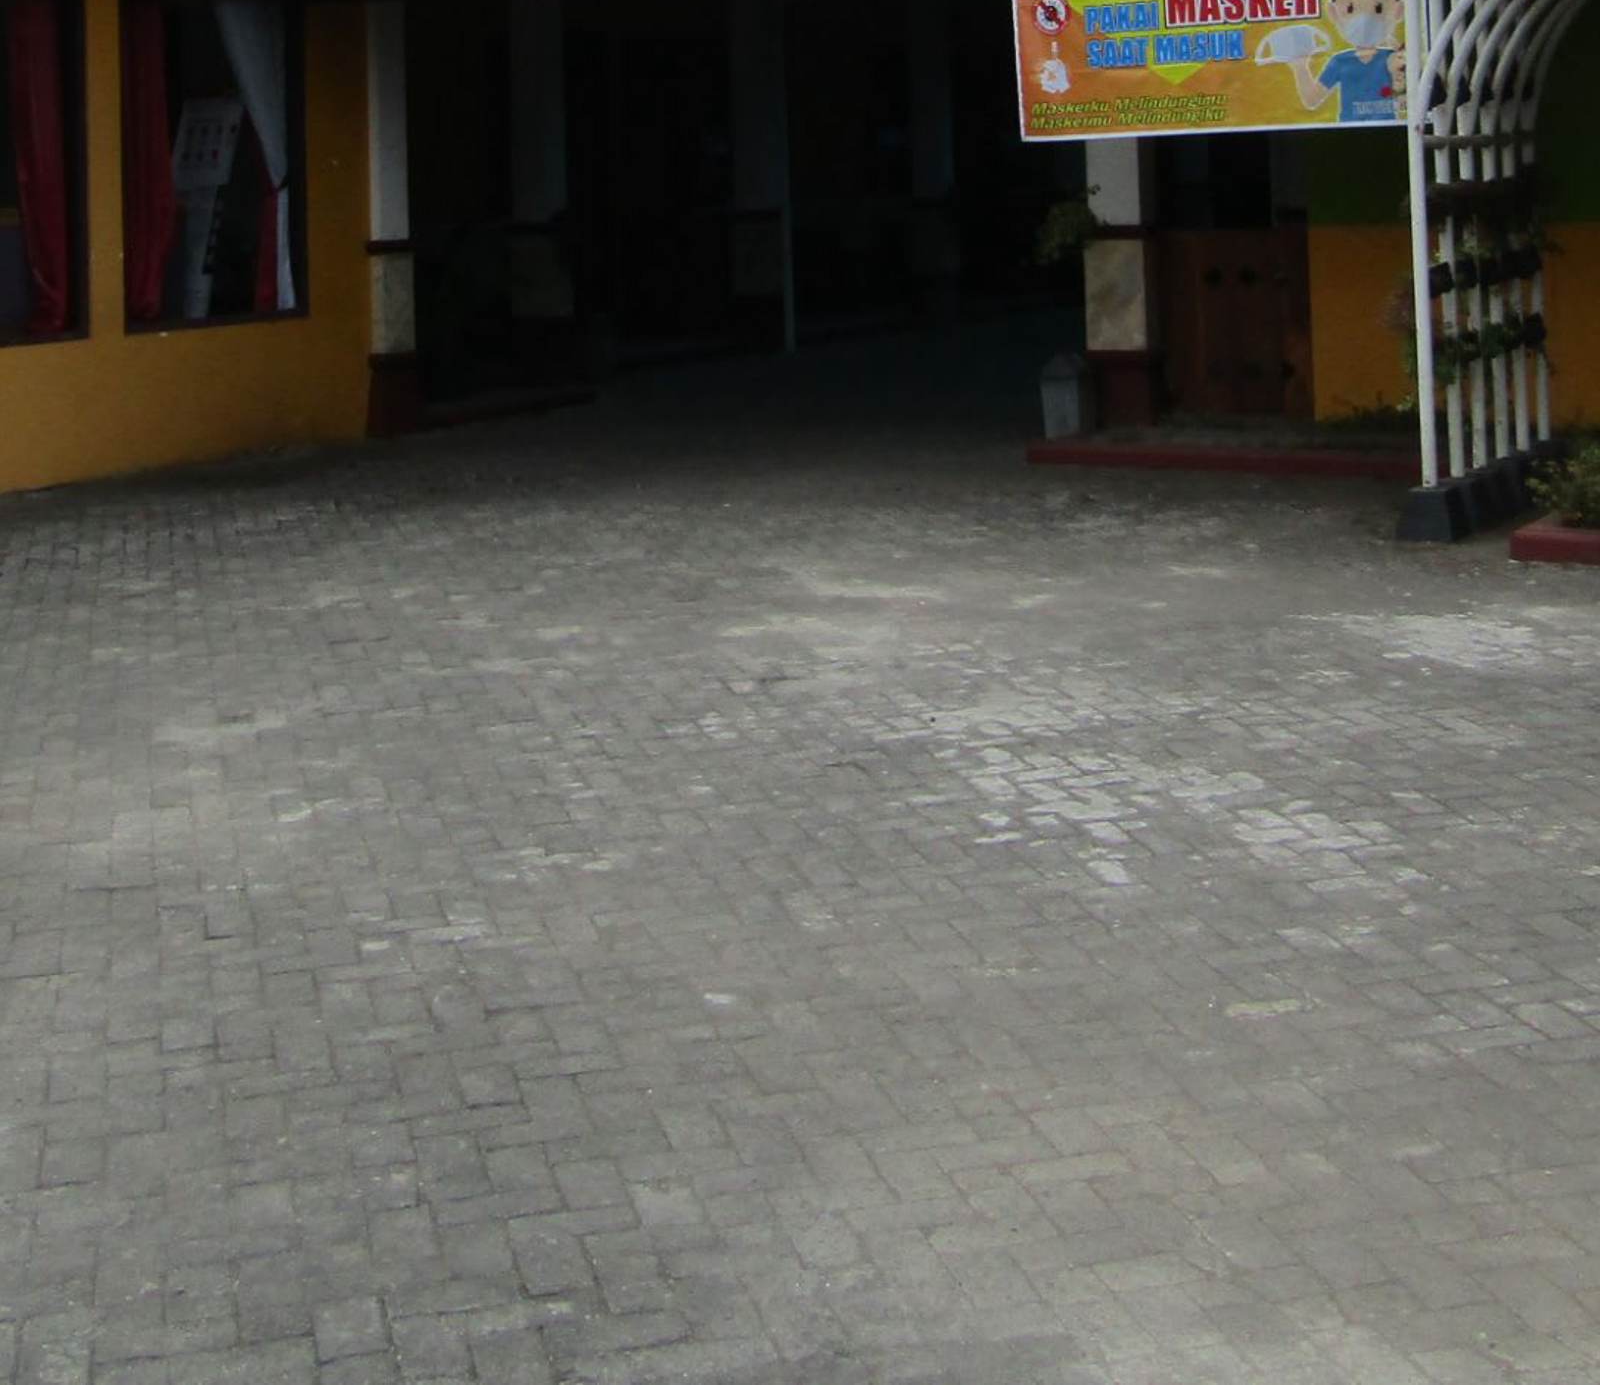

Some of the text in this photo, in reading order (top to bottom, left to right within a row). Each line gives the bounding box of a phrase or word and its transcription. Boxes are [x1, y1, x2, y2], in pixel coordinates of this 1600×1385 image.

[1085, 1, 1159, 34] PAKAI
[1087, 31, 1245, 68] SAAT MASUK
